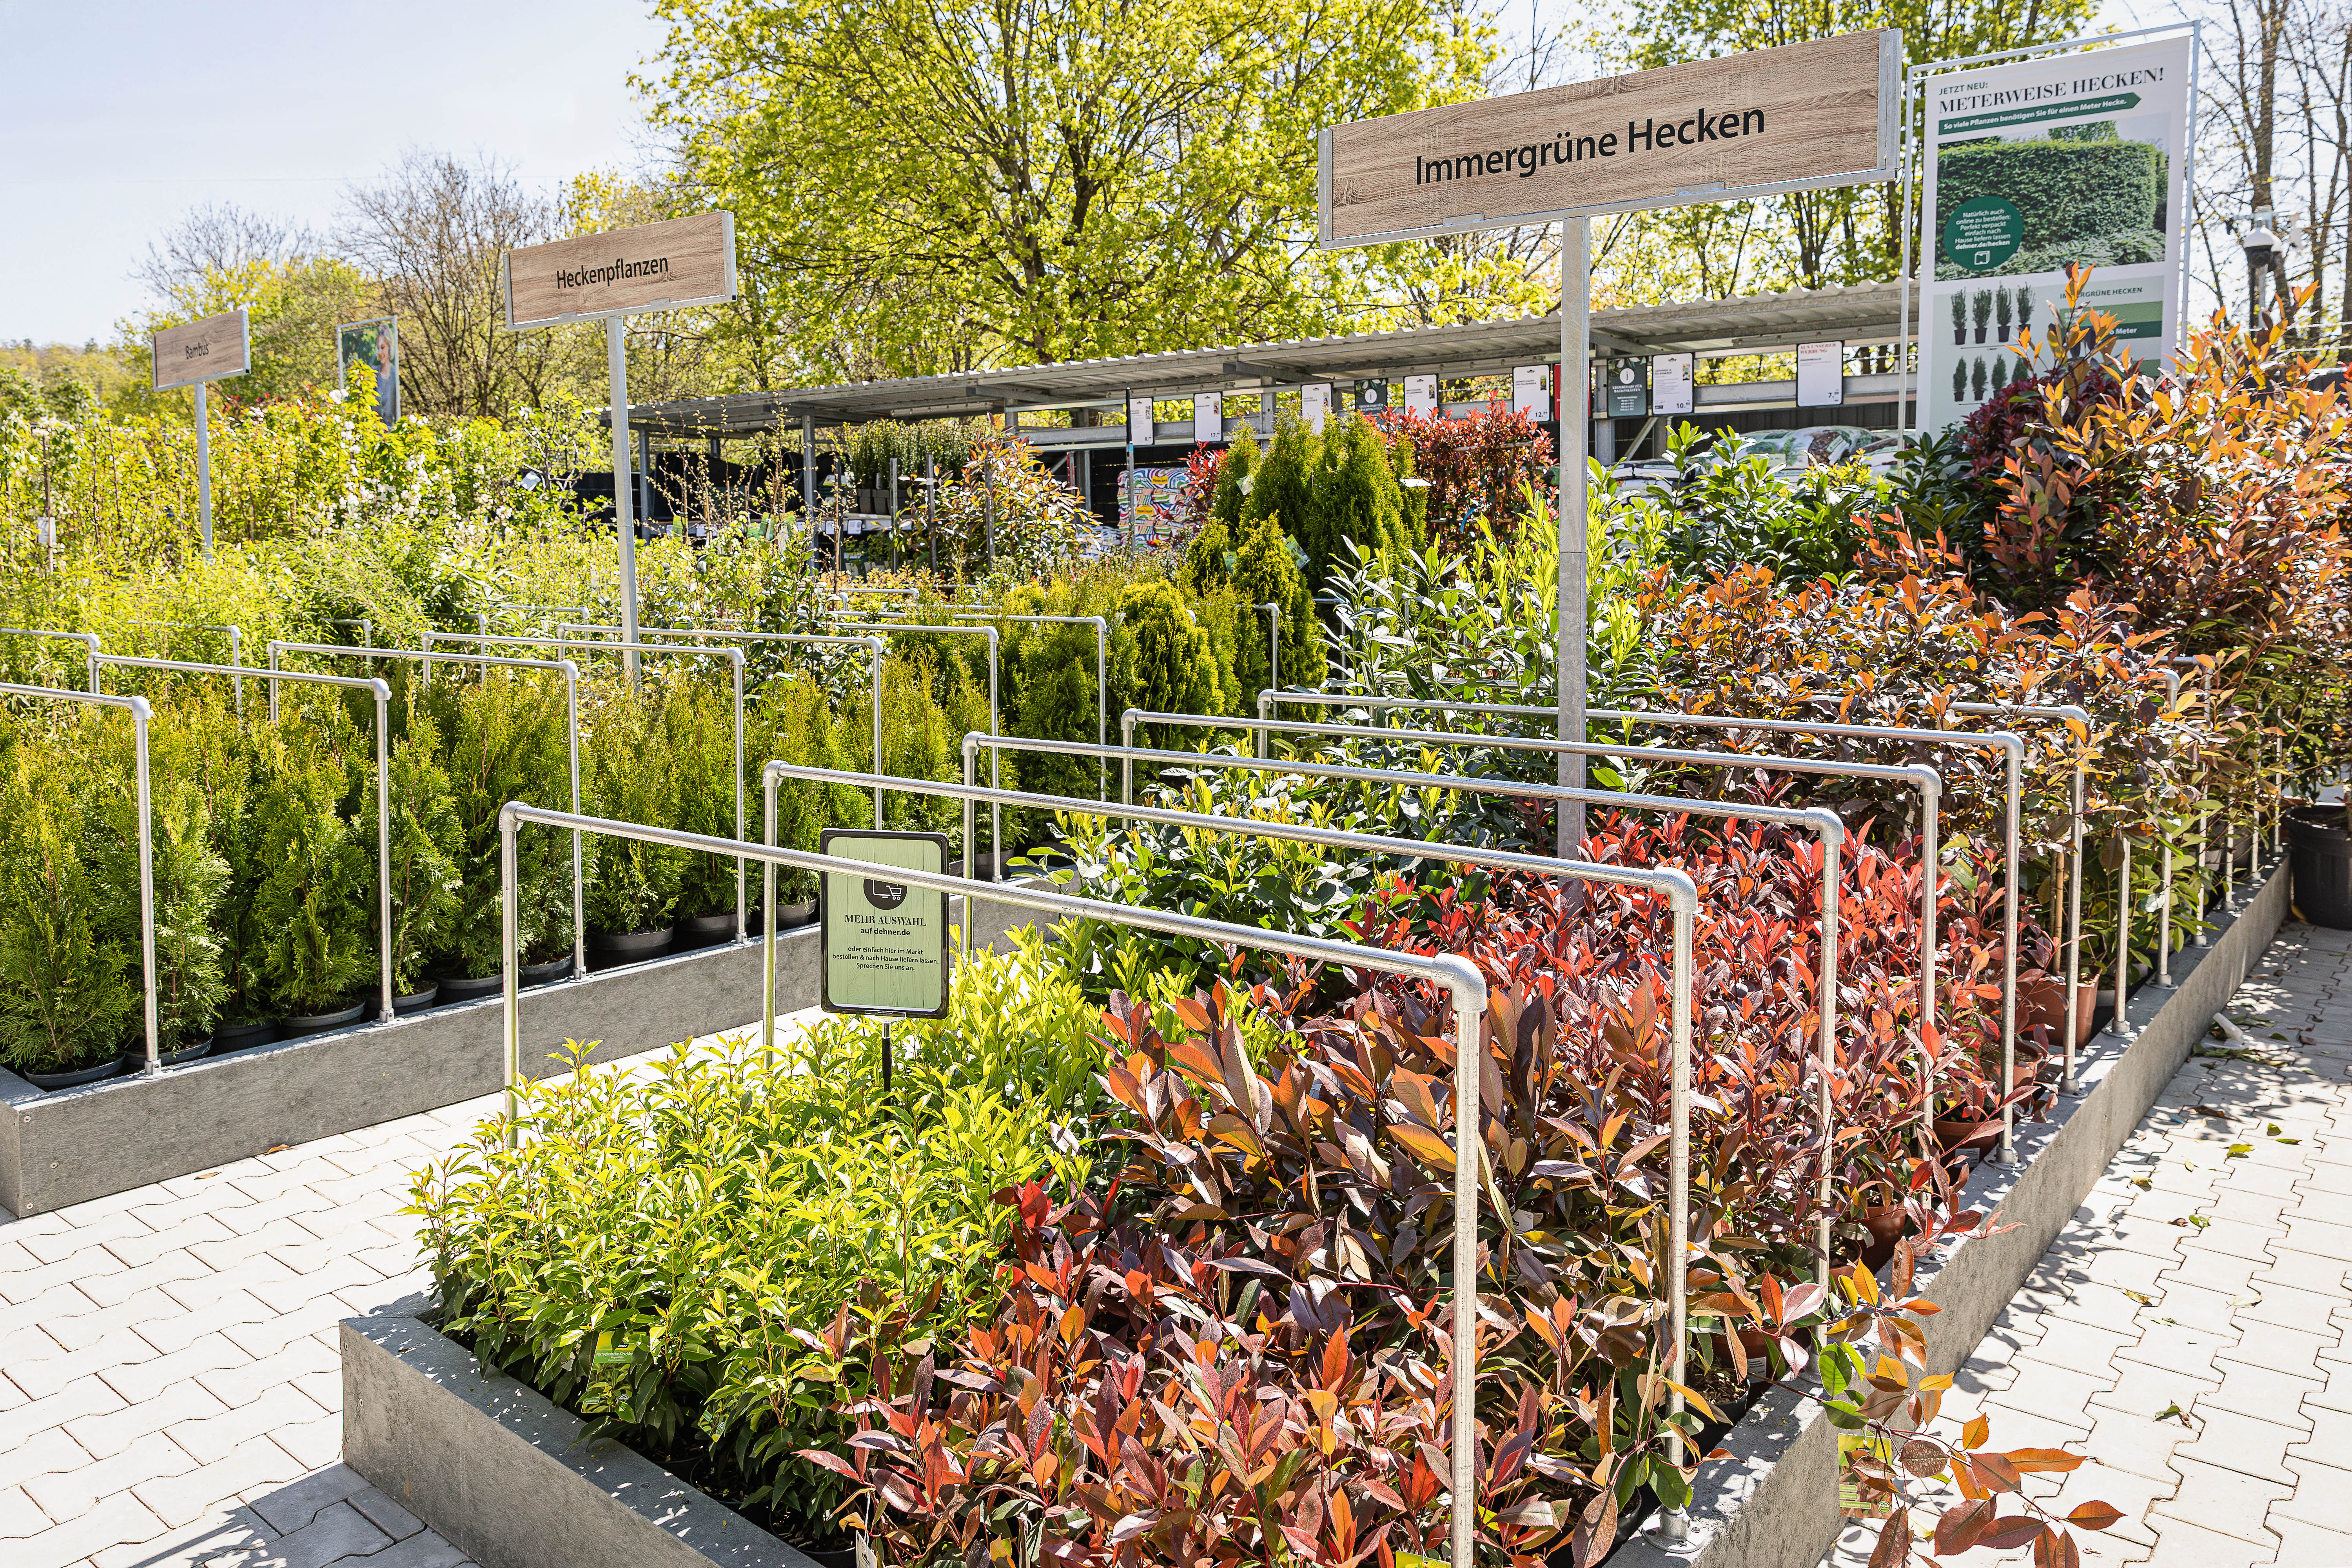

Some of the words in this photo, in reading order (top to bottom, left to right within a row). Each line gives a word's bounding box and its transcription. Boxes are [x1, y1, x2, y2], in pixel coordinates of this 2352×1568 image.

[1939, 85, 1965, 95] JETZT
[1967, 82, 1988, 91] NEU:
[1940, 82, 2067, 114] METERWEISE
[2073, 67, 2163, 94] HECKEN!
[1970, 117, 1999, 126] Pflanzen
[2000, 112, 2034, 122] benötigen
[2102, 99, 2127, 107] Hecke.
[1416, 132, 1617, 186] Immergrüne
[1628, 108, 1764, 153] Hecken
[1955, 240, 2010, 250] dehner.de/hecken
[557, 257, 668, 289] Heckenpflanzen
[185, 342, 209, 359] Bambus
[844, 915, 875, 924] MEHR
[878, 916, 927, 926] AUSWAHL
[856, 962, 883, 971] Sprechen
